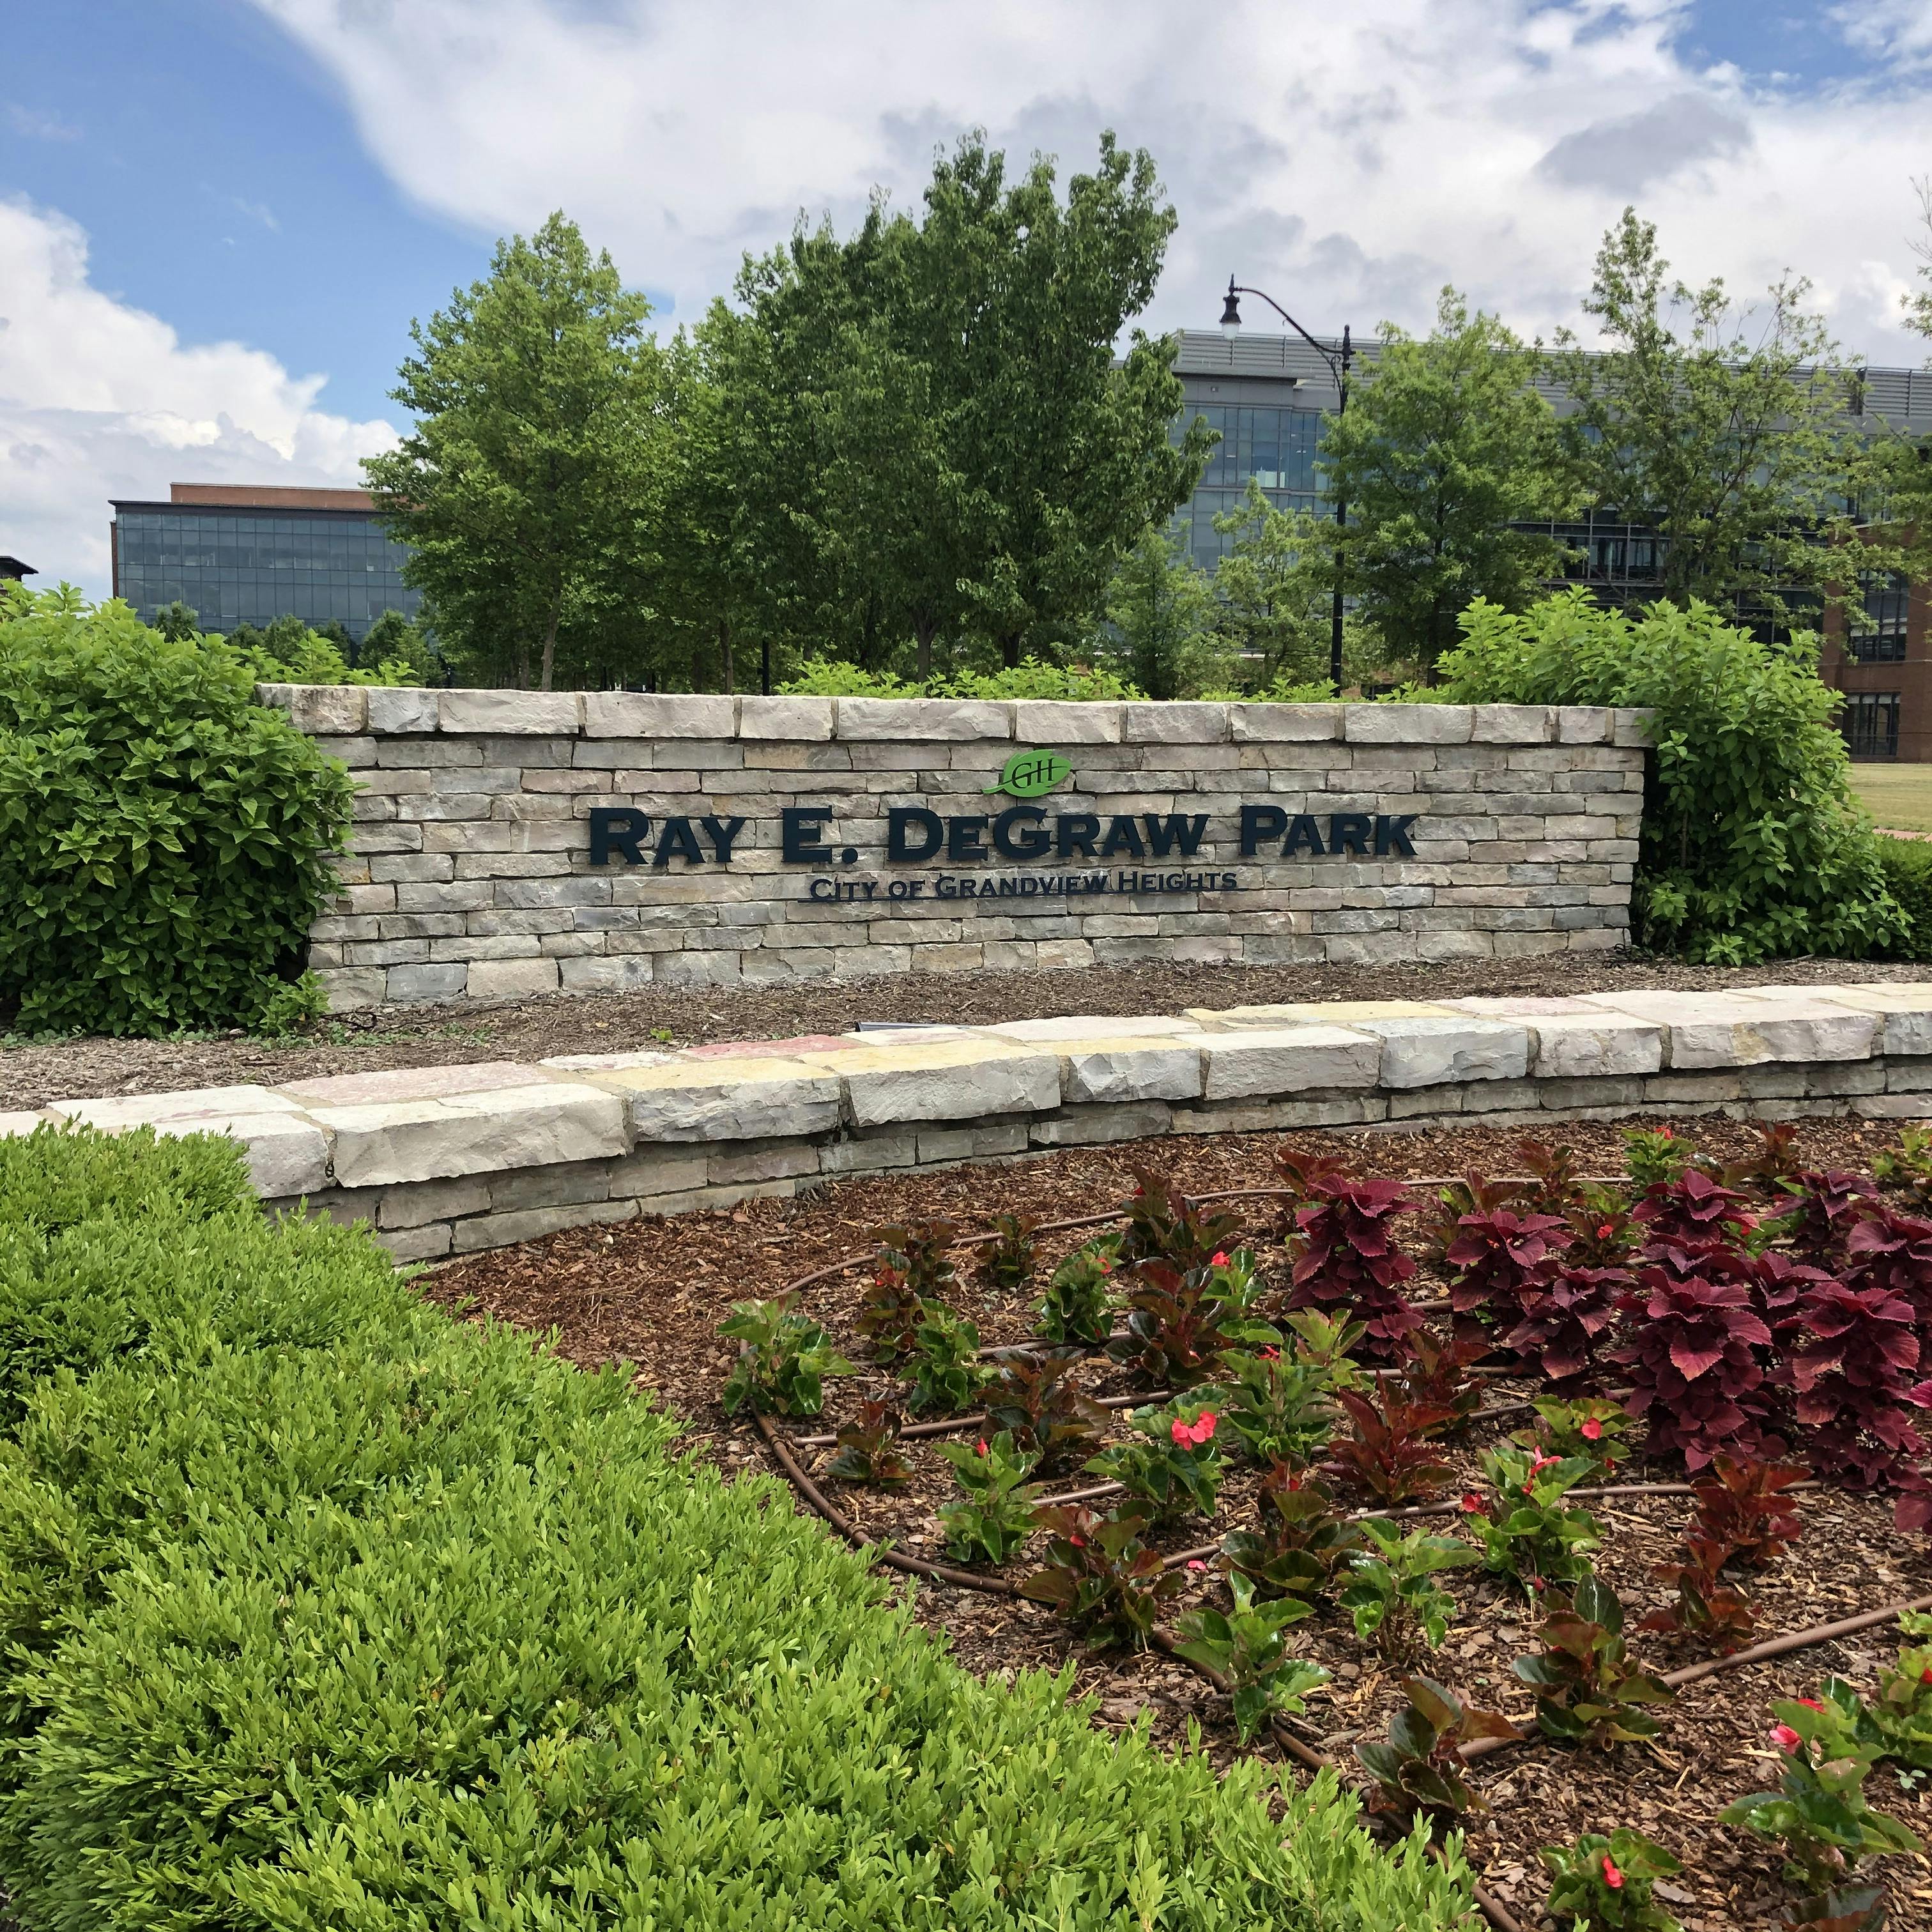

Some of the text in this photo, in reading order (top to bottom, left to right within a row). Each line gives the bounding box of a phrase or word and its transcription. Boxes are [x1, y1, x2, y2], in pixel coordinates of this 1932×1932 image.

[1011, 758, 1054, 788] GH
[589, 805, 1420, 866] RAY E. DEGRAW PARK
[809, 870, 1238, 902] CITY OF GRANDVIEW HEIGHTS
